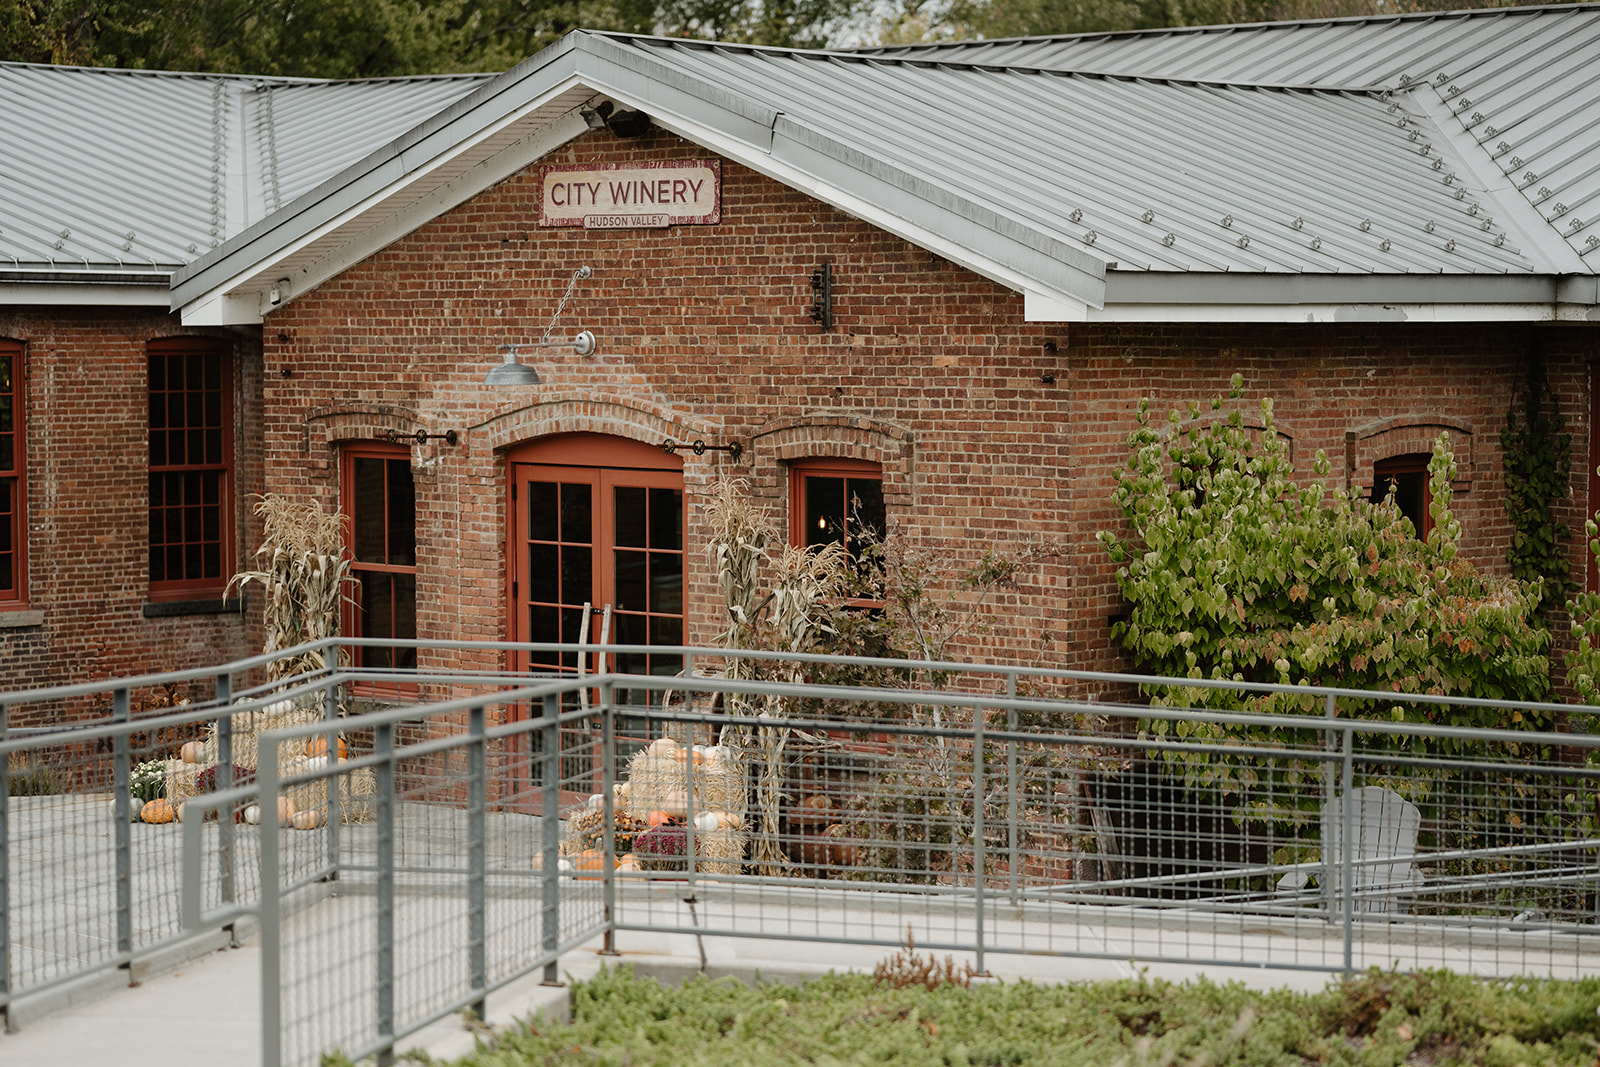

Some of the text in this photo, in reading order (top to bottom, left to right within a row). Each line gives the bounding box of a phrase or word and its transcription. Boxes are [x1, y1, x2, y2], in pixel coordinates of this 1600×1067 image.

[551, 179, 704, 206] CITY WINERY
[589, 215, 664, 227] HUDSON VALLEY
